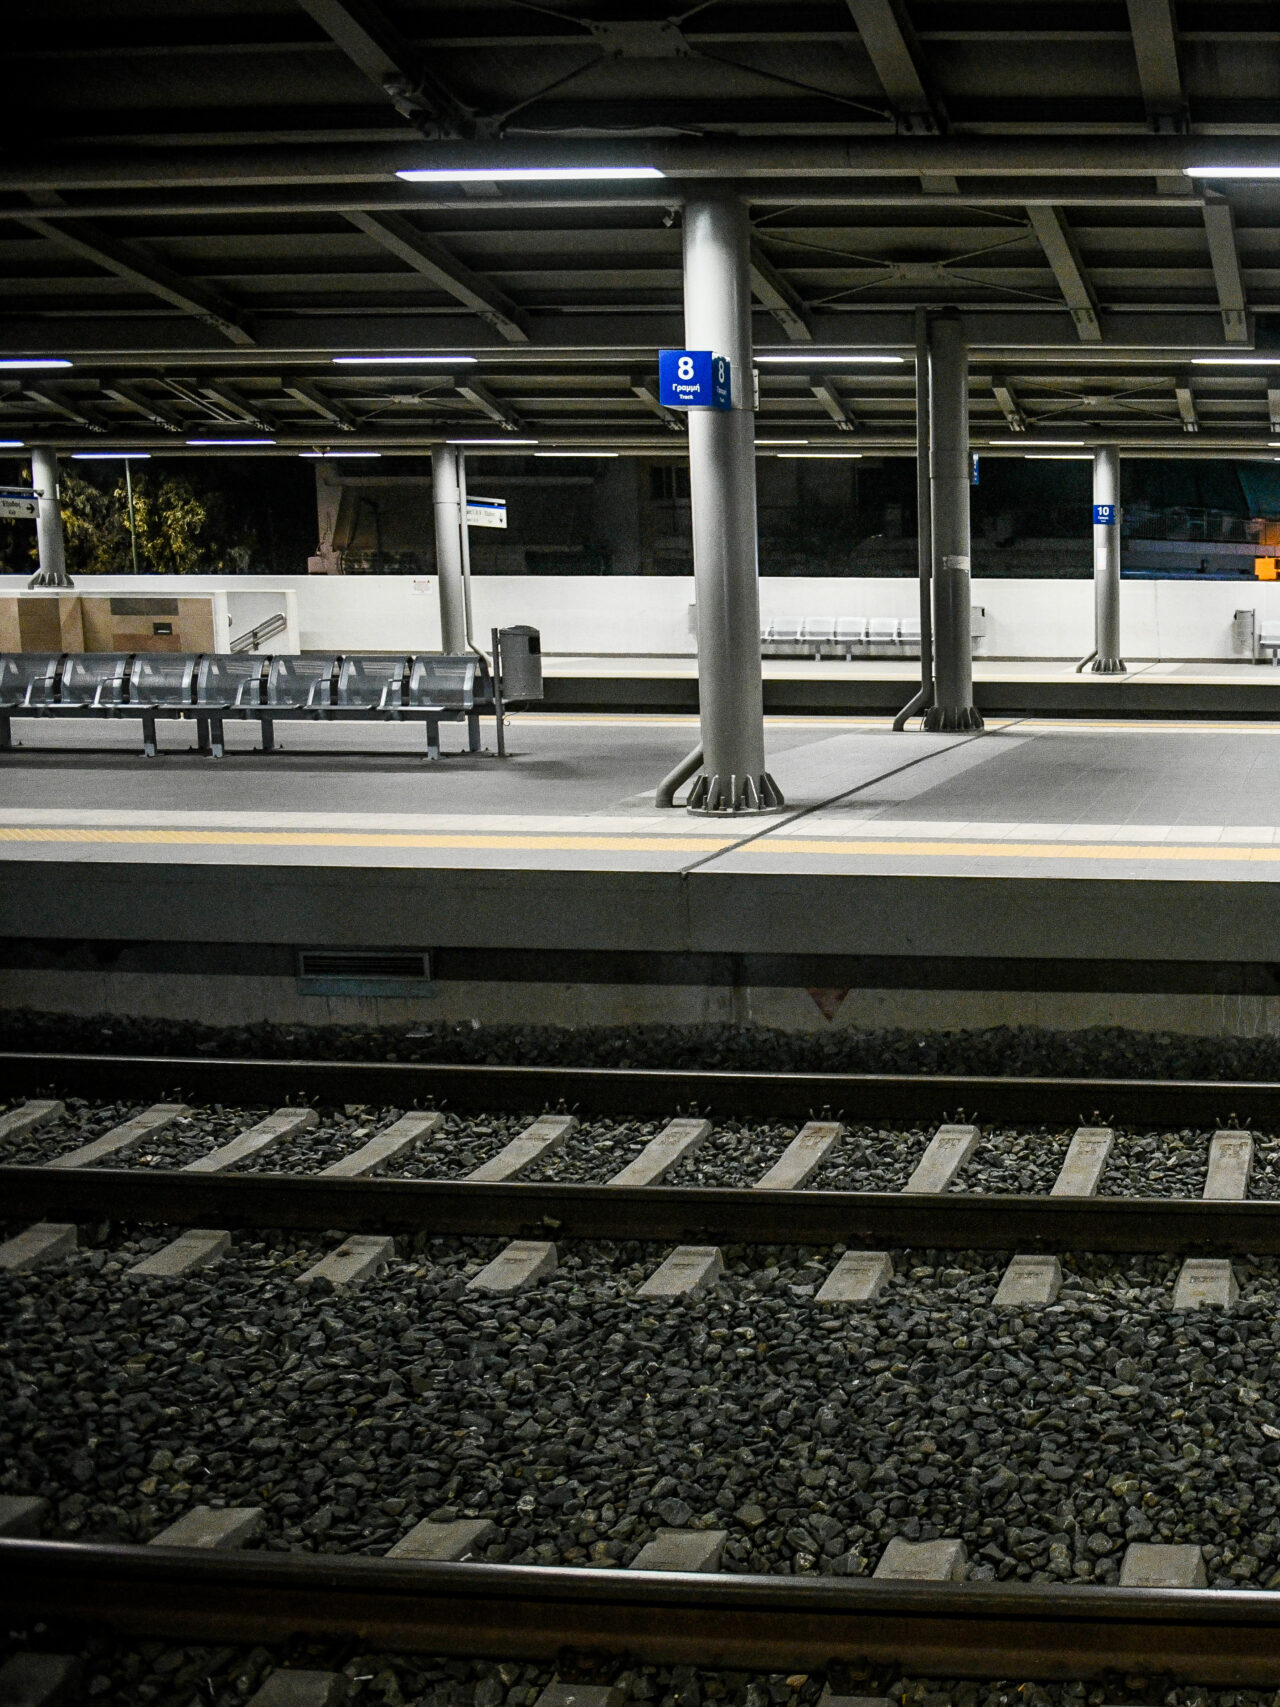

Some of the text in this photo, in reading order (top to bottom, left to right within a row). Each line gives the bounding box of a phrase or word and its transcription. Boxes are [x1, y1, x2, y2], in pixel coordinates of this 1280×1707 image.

[677, 356, 694, 380] 8
[718, 360, 725, 383] 8
[672, 383, 701, 393] Γραμμή
[1097, 506, 1110, 516] 10
